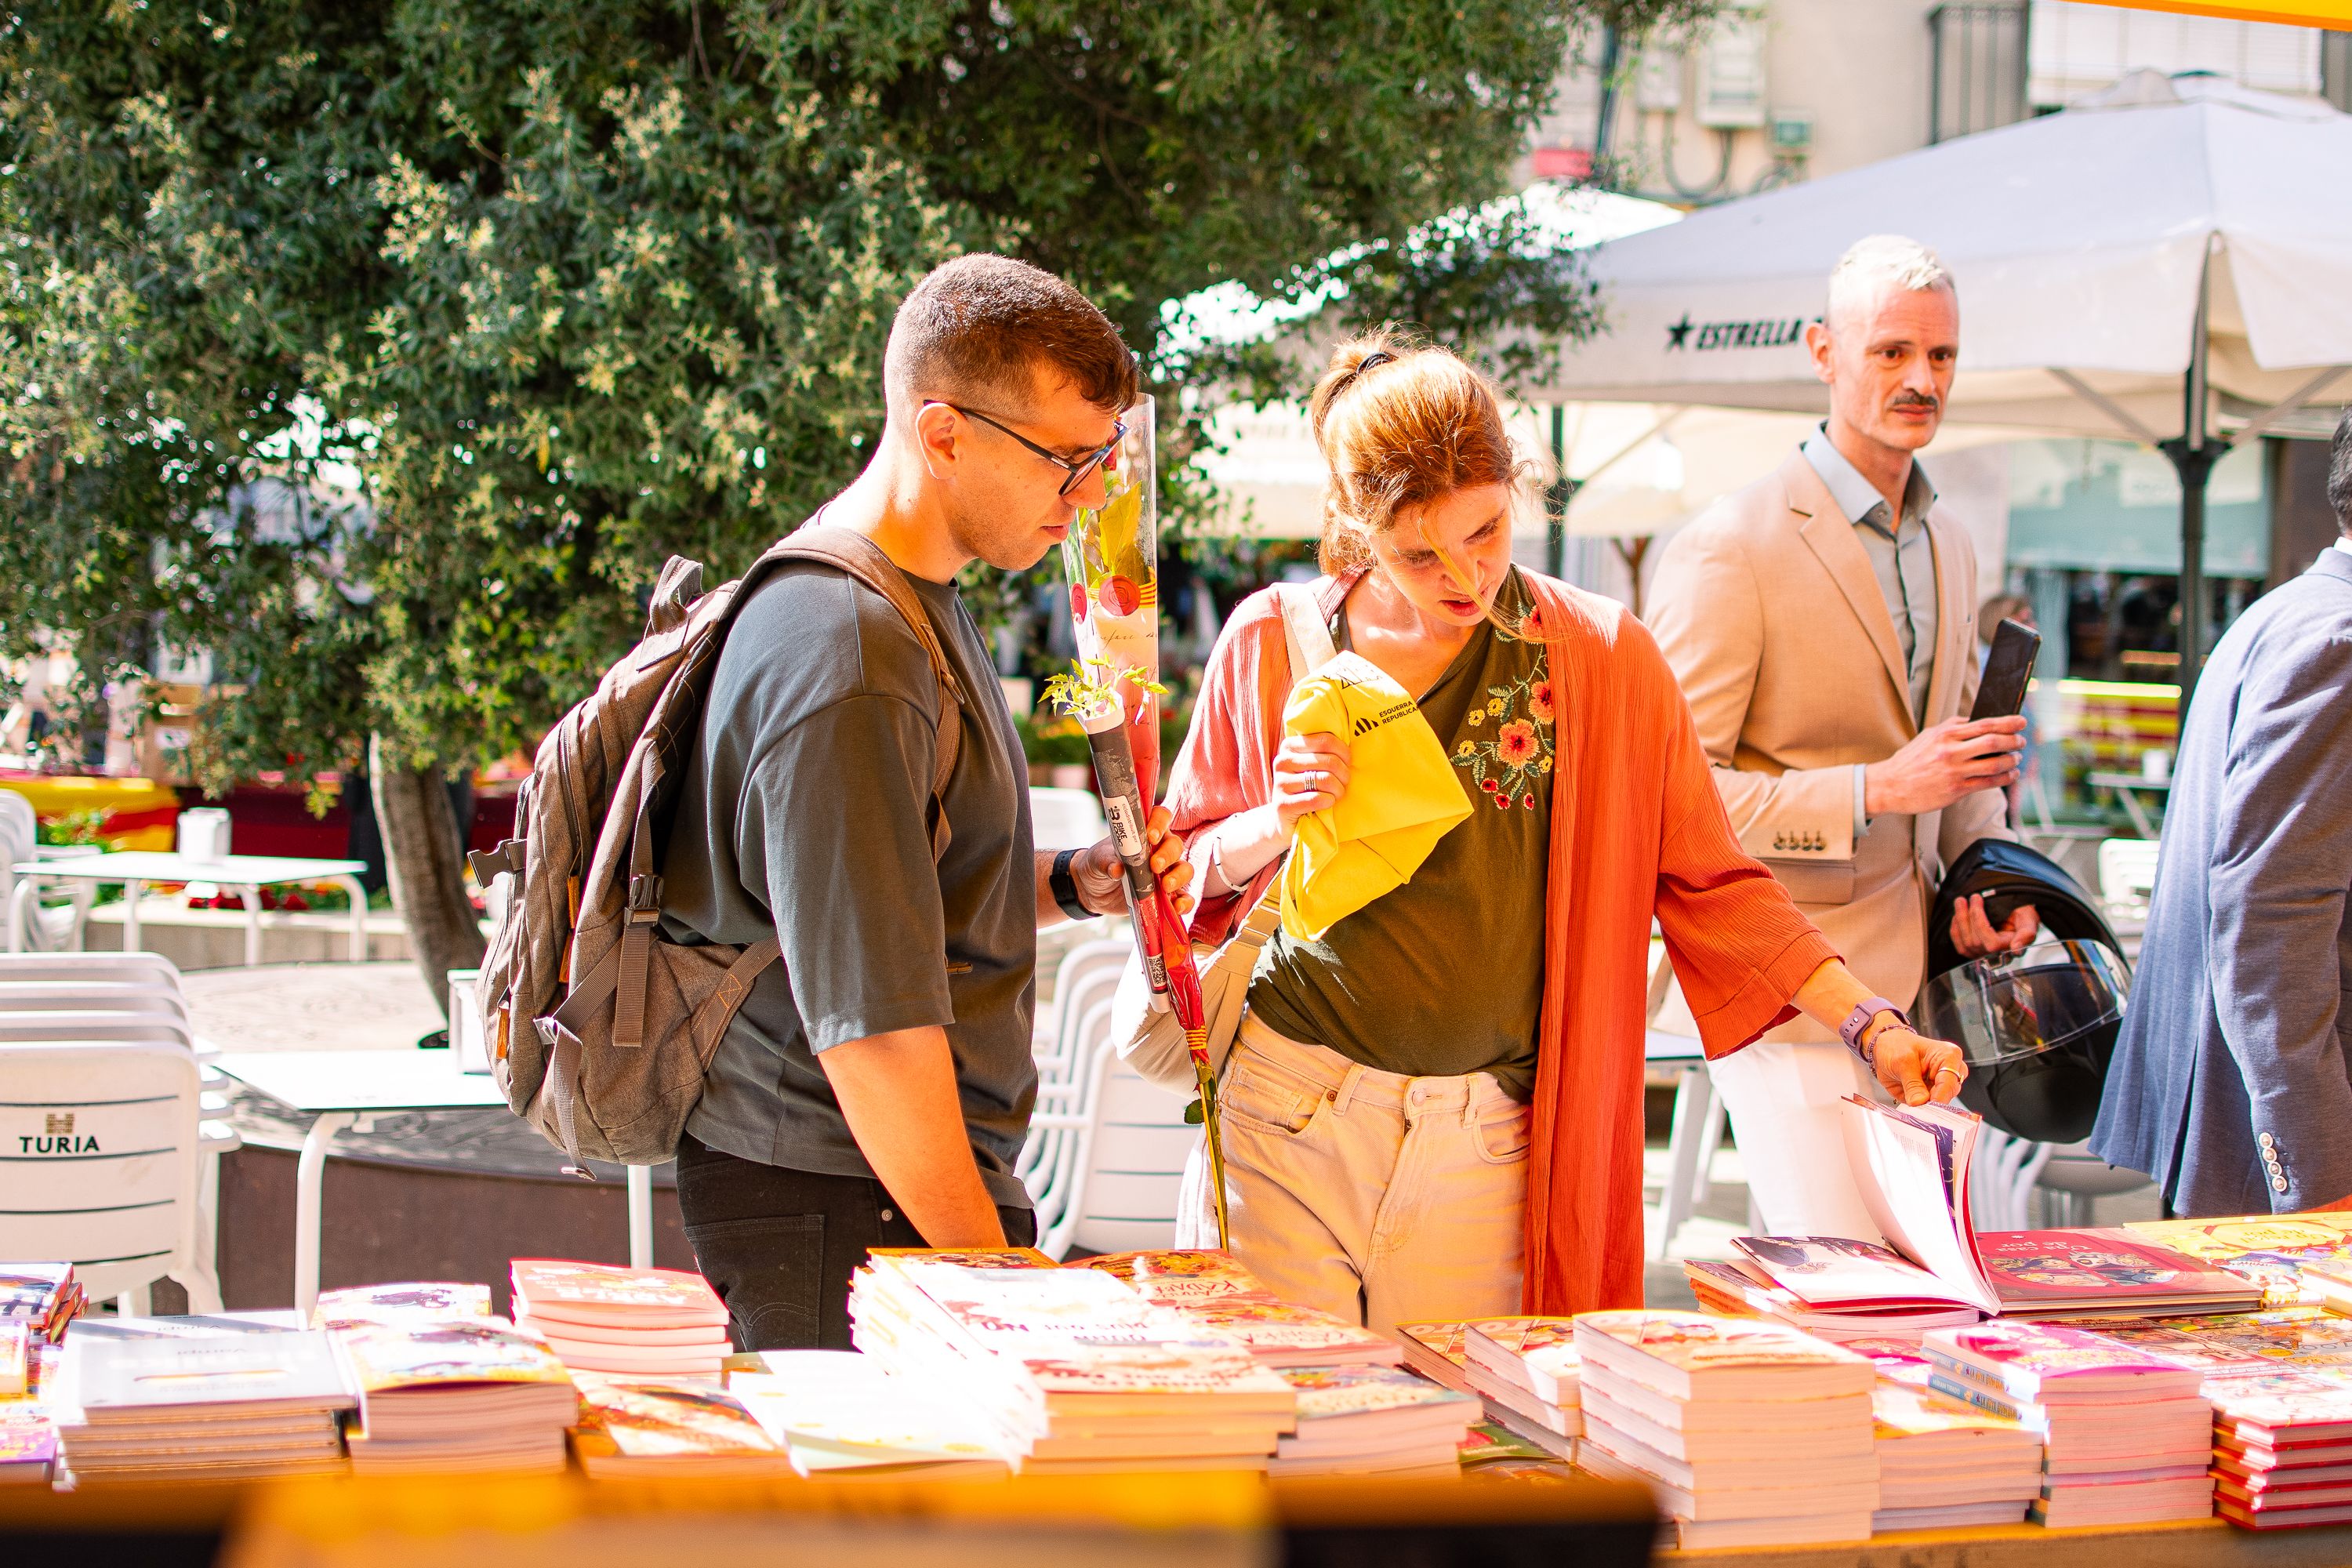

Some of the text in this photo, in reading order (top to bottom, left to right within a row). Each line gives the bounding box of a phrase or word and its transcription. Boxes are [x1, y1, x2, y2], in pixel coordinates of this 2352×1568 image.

[1696, 318, 1802, 350] ESTRELLA
[1379, 700, 1413, 718] ESQUERRA
[1381, 706, 1419, 725] REPUBLICA
[1116, 822, 1127, 840] BIKE
[19, 1135, 100, 1153] TURIA
